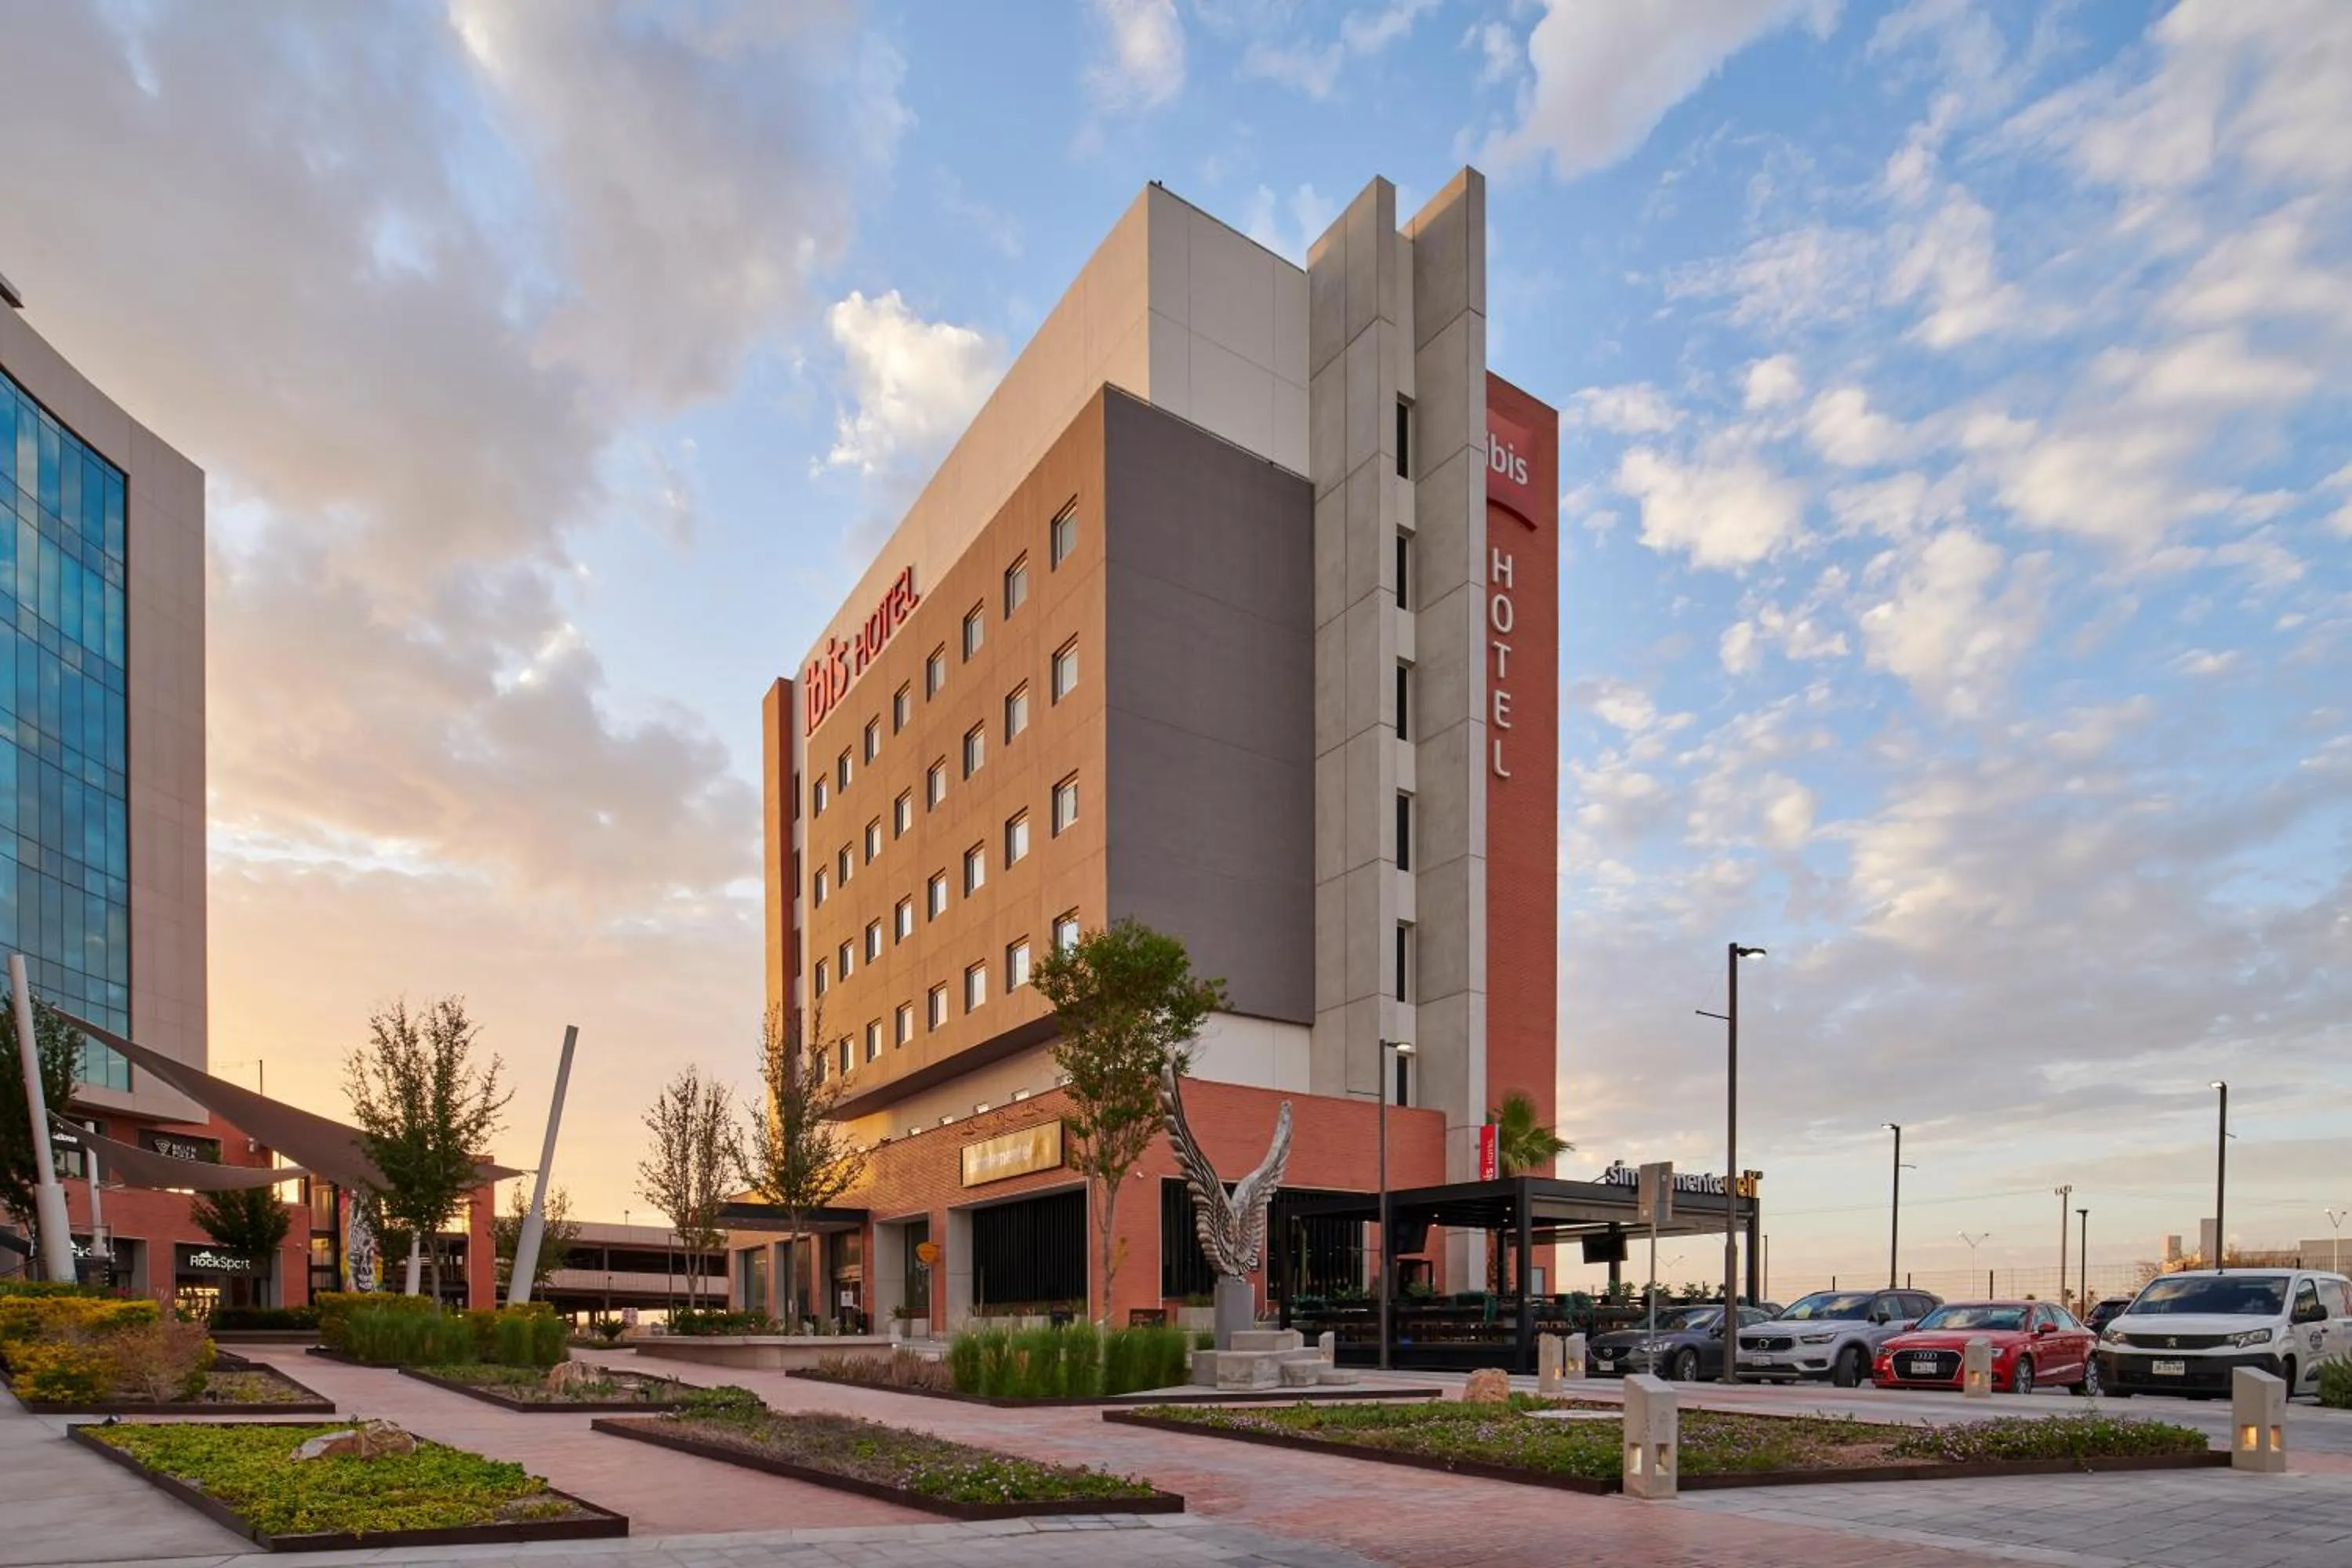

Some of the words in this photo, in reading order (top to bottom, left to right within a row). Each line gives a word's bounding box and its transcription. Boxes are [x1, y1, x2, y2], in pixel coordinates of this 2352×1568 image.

[805, 637, 849, 737] ibis
[855, 565, 920, 677] HOTEL
[1491, 547, 1513, 777] HOTEL
[190, 1253, 251, 1271] RockSport
